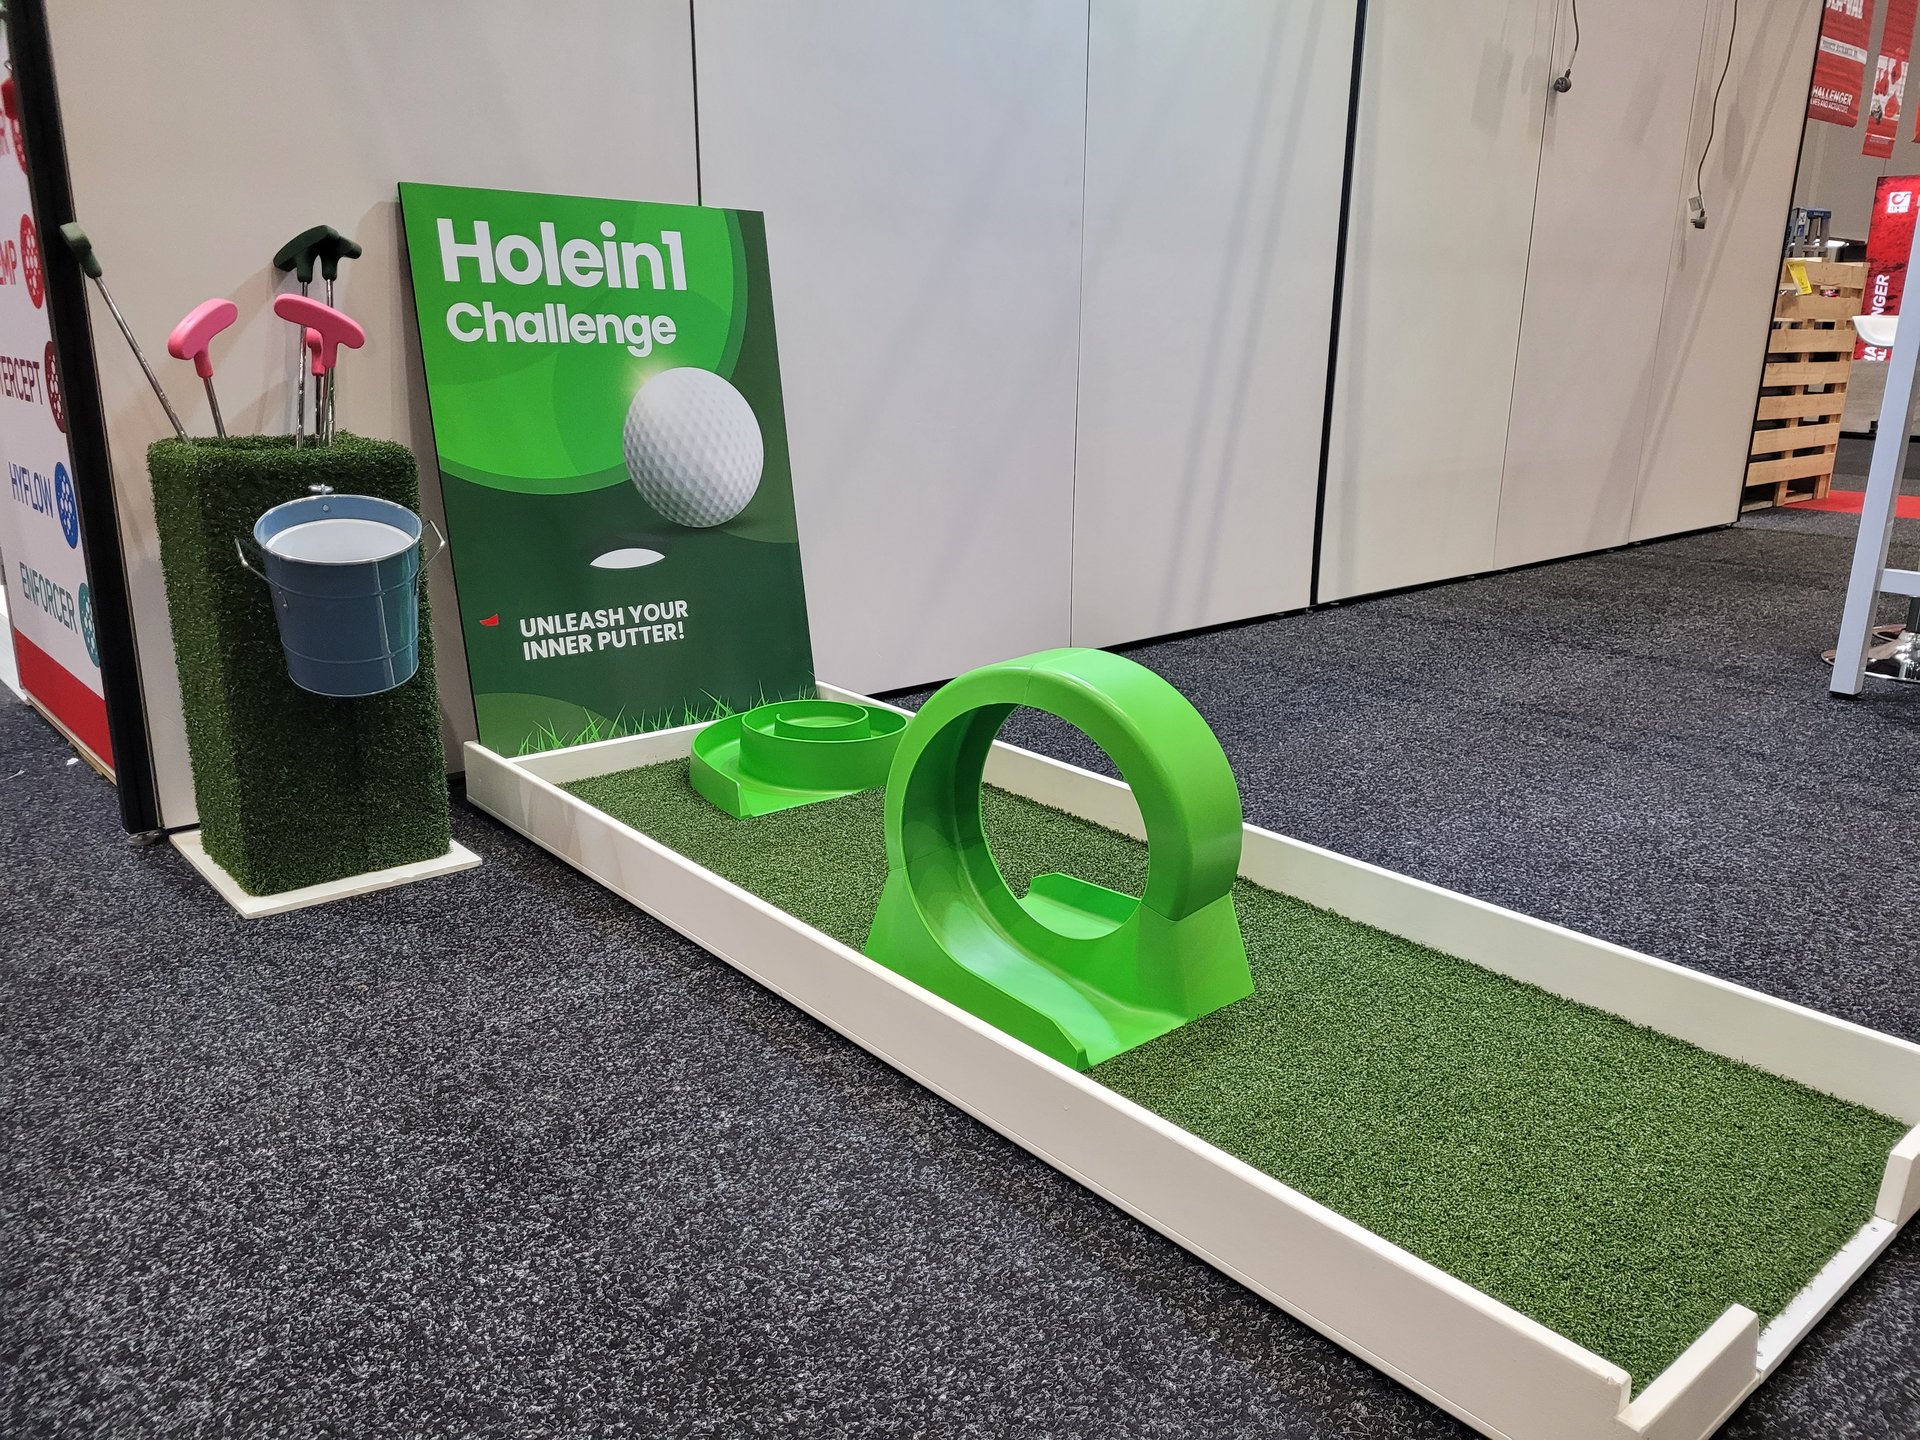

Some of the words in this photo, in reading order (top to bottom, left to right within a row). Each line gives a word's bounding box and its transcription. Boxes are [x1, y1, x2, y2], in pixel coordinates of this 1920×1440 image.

[436, 217, 688, 292] Holein1
[446, 302, 678, 358] Challenge
[8, 461, 54, 518] HYFLOW
[19, 561, 78, 634] ENFORCER
[519, 607, 625, 638] UNLEASH
[627, 600, 689, 624] YOUR
[522, 634, 594, 661] INNER
[597, 621, 685, 650] PUTTER!
